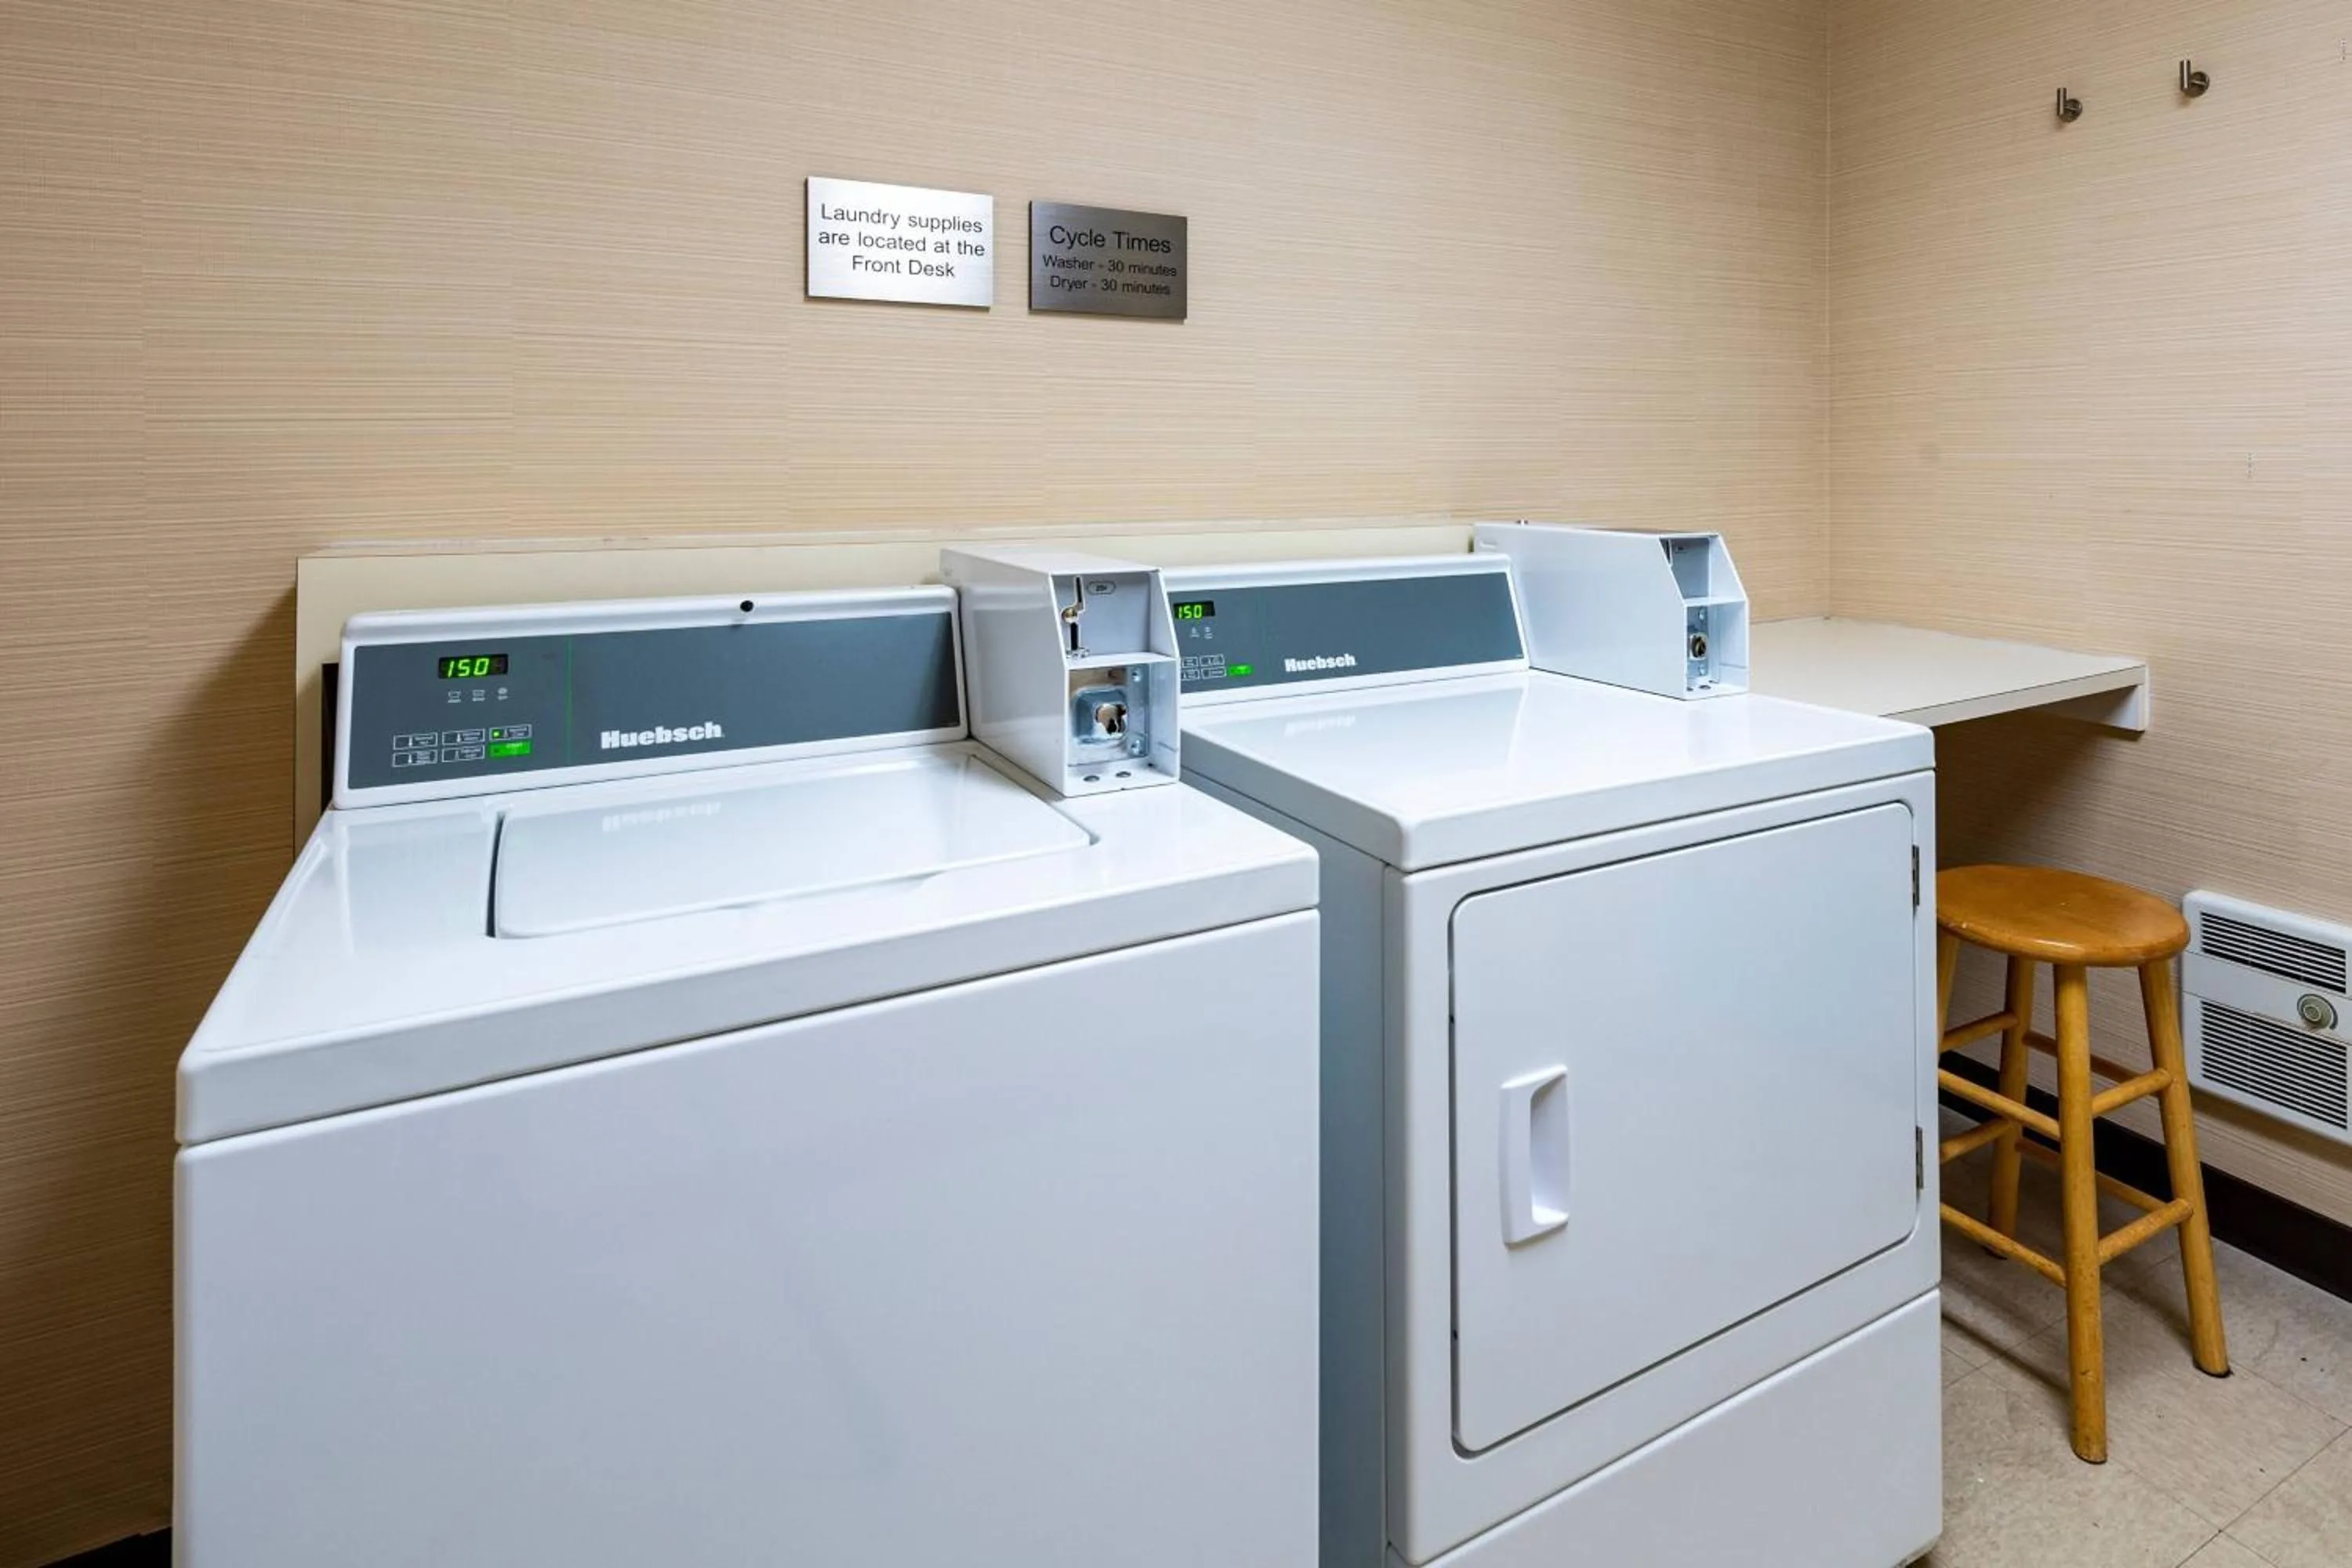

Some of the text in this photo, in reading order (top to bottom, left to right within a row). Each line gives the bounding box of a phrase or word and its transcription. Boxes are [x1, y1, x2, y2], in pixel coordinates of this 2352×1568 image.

[821, 203, 983, 234] Laundry supplies
[818, 230, 985, 257] are located at the
[1049, 225, 1172, 254] Cycle Times
[851, 254, 956, 278] Front Desk
[1042, 254, 1095, 271] Washer
[1107, 259, 1124, 273] 30
[1128, 262, 1178, 277] minutes
[1049, 274, 1088, 292] Dryer
[1101, 278, 1117, 292] 30
[1122, 281, 1171, 296] minutes
[1178, 604, 1203, 619] 150
[447, 657, 490, 678] 150
[1284, 652, 1356, 673] Huebsch
[601, 720, 722, 750] Huebsch
